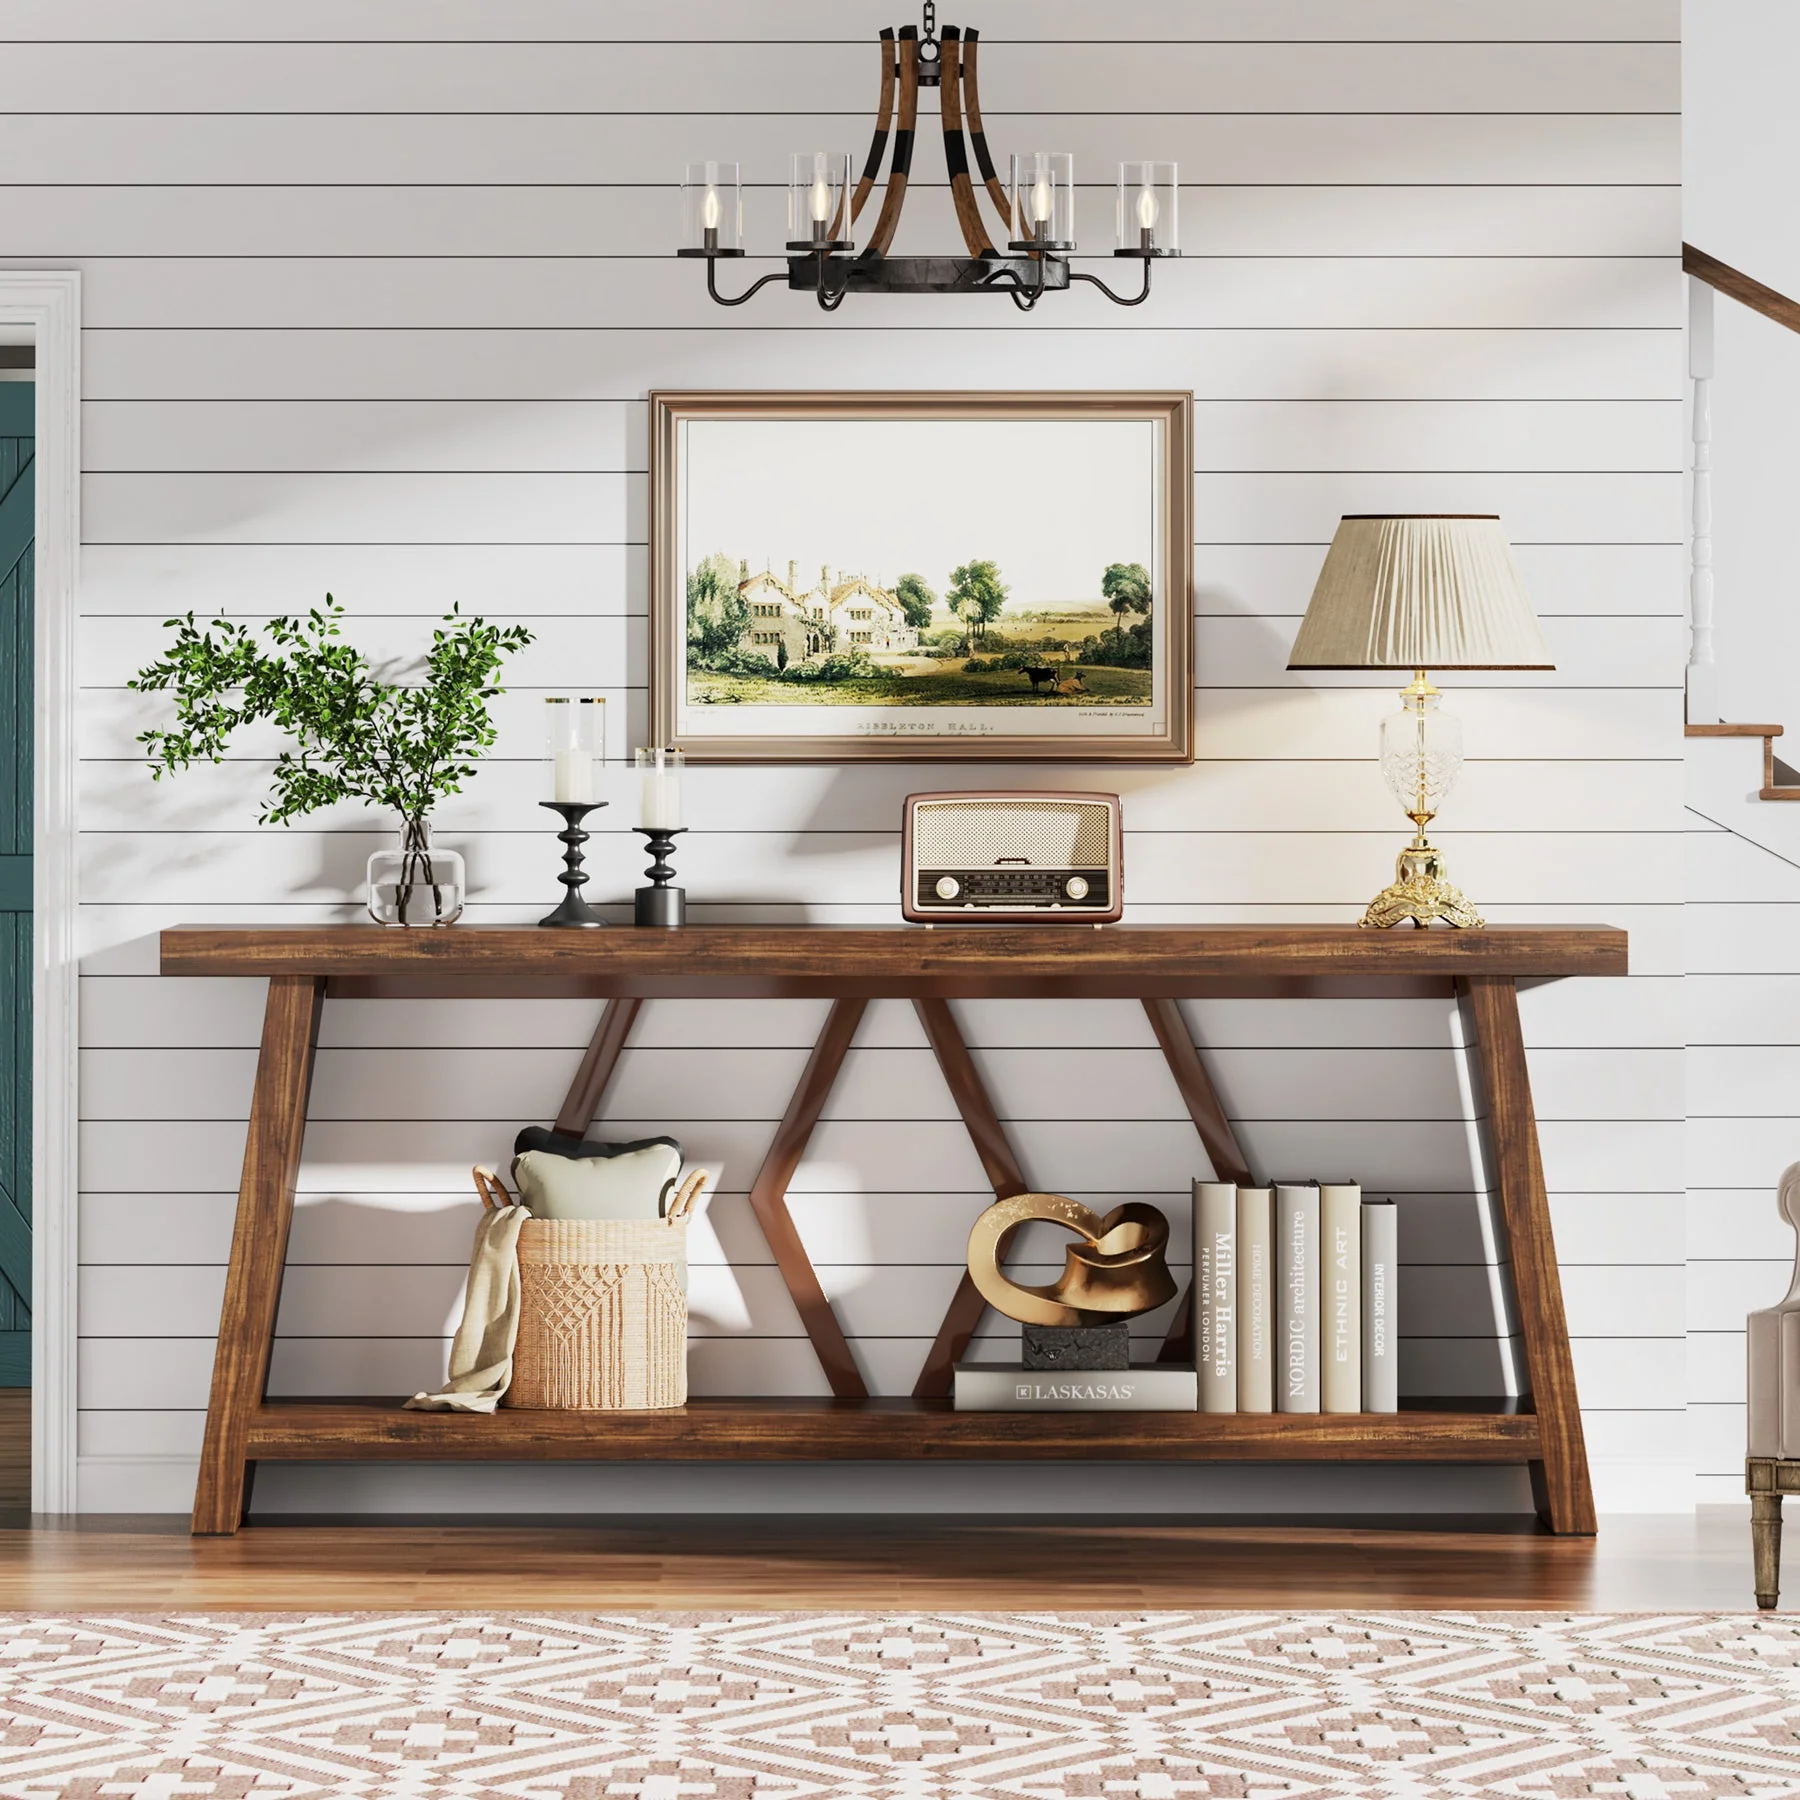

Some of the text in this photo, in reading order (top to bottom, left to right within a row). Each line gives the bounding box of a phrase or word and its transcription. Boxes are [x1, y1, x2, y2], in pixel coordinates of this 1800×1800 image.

[1202, 1247, 1210, 1362] PERFUMER LONDON
[1215, 1232, 1232, 1377] Miller Harris
[1252, 1244, 1261, 1360] HOME DECORATION
[1289, 1210, 1305, 1397] NORDIC architecture
[1336, 1226, 1348, 1362] ETHNIC ART
[1374, 1263, 1385, 1357] INTERIOR DECOR
[1035, 1385, 1132, 1400] LASKASAS
